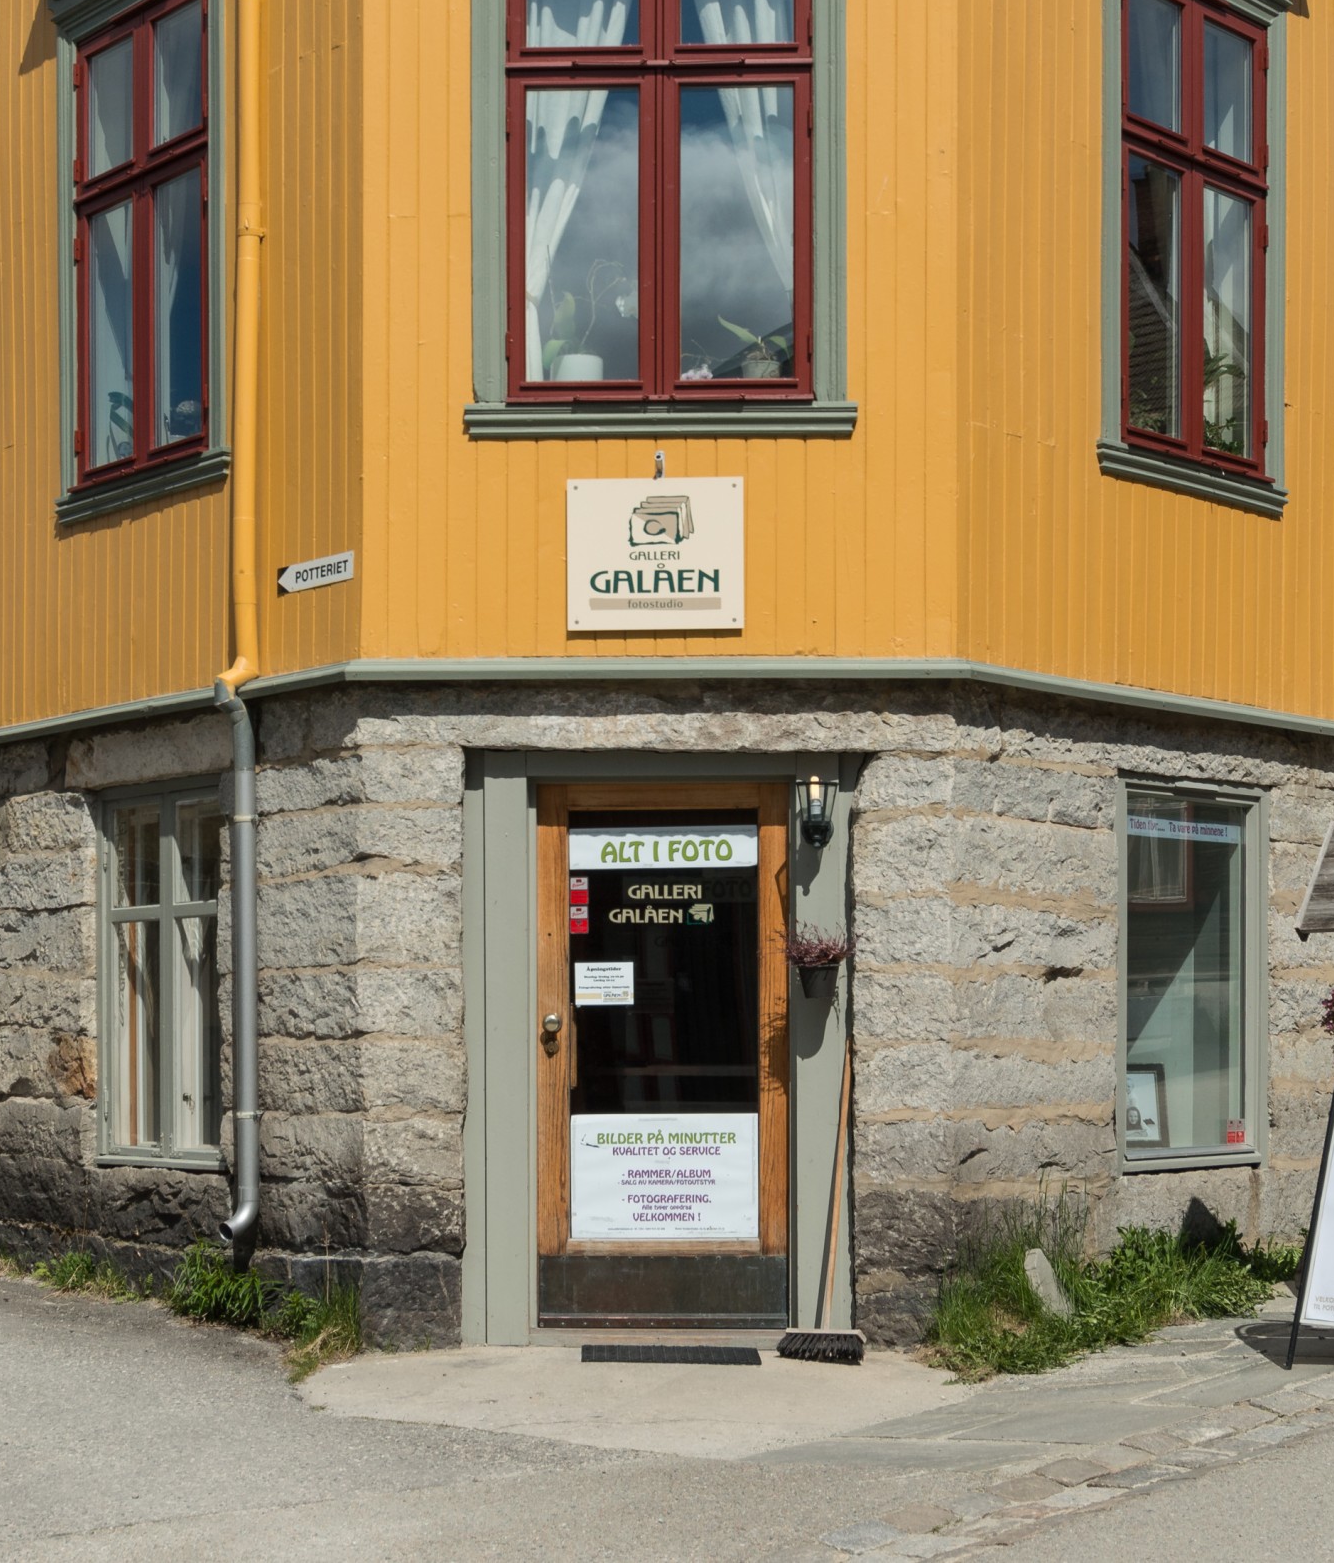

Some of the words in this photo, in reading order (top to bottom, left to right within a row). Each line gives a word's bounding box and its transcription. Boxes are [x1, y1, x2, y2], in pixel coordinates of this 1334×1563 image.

[629, 550, 680, 561] GALLERI
[295, 559, 349, 584] POTTERIET
[589, 563, 720, 594] GALÅEN
[627, 599, 684, 609] fotostudio
[1129, 818, 1147, 830] Tiden
[1169, 821, 1177, 833] Ta
[601, 841, 645, 863] ALT
[653, 841, 659, 862] I
[668, 839, 733, 862] FOTO
[628, 885, 702, 899] GALLERI
[609, 905, 683, 924] GALÅEN
[597, 1133, 643, 1145] BILDER
[647, 1129, 664, 1145] PÅ
[668, 1132, 736, 1144] MINUTTER
[612, 1147, 659, 1156] KVALITET
[663, 1147, 676, 1155] OG
[679, 1146, 721, 1155] SERVICE
[628, 1169, 711, 1179] RAMMER/ALBUM
[627, 1194, 712, 1204] FOTOGRAFERING.
[633, 1212, 695, 1222] VELKOMMEN
